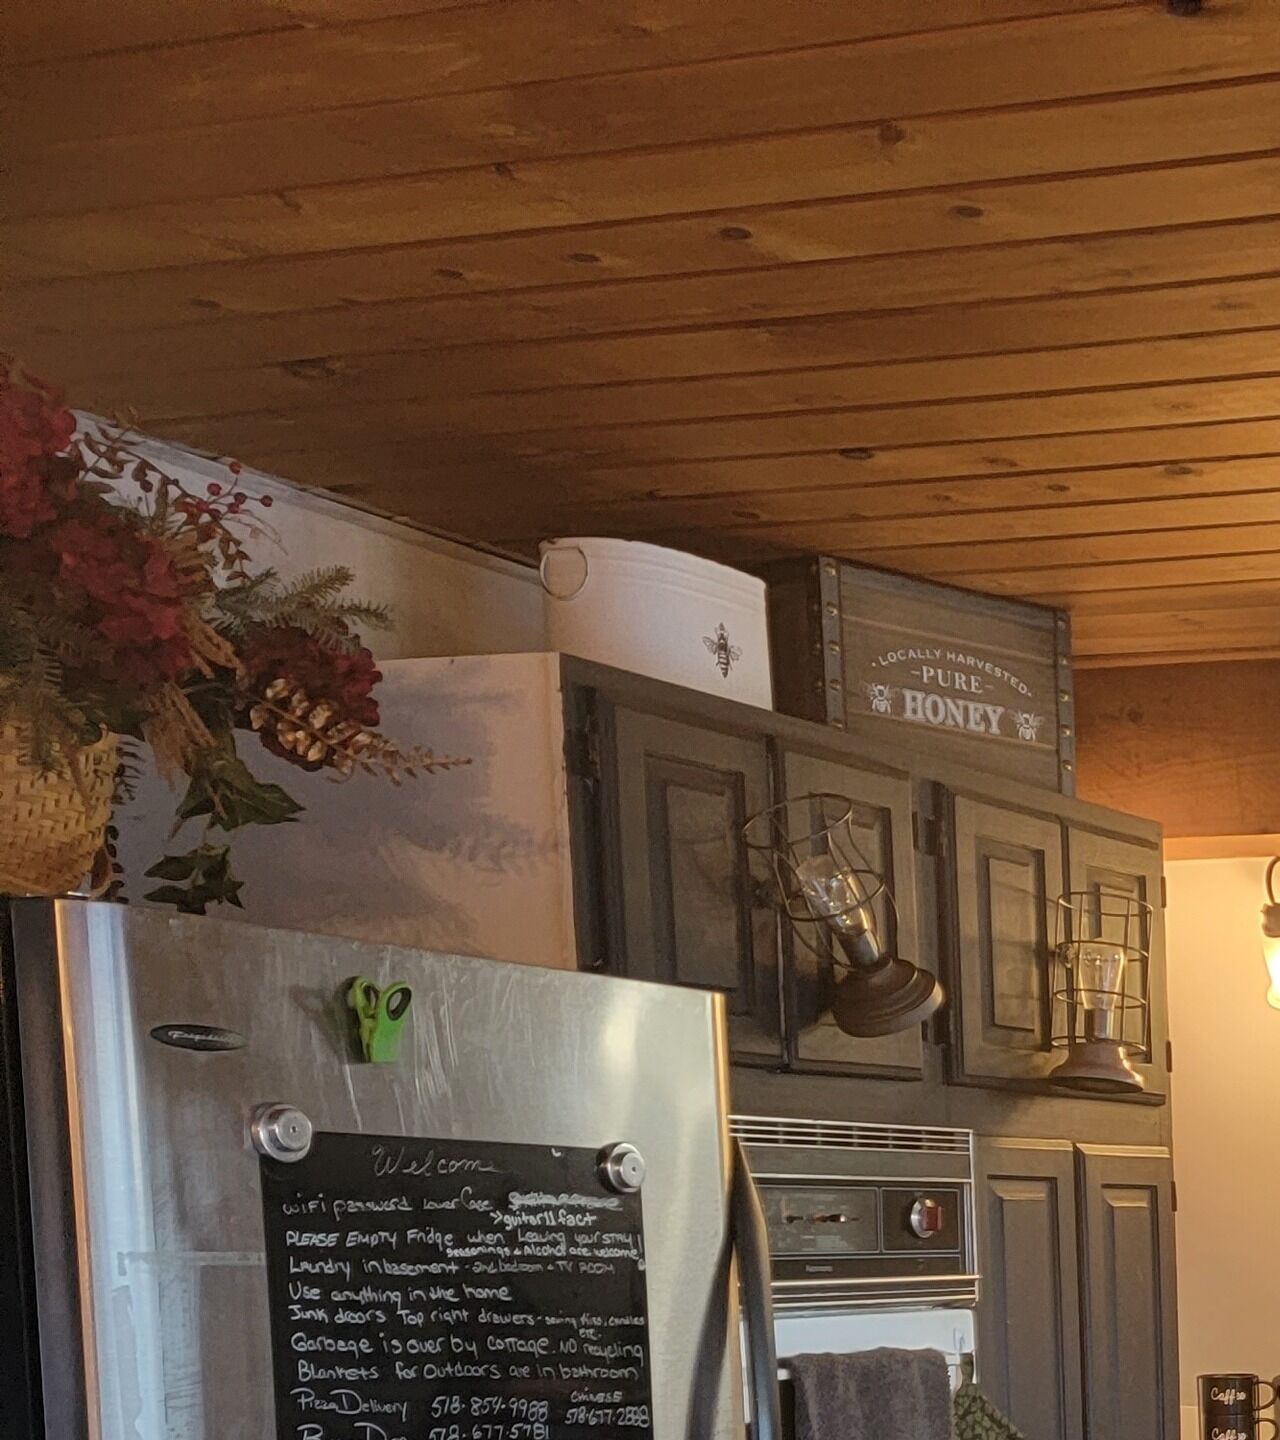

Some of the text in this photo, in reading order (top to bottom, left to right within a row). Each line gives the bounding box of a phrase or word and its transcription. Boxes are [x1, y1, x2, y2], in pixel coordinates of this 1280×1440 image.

[879, 649, 1028, 696] LOCALLY HARVESTED
[922, 666, 983, 694] PURE
[902, 687, 1005, 735] HONEY
[372, 1144, 500, 1177] Welcome
[286, 1231, 339, 1247] PLEASE
[467, 1231, 505, 1244] when
[289, 1281, 321, 1300] Use
[331, 1286, 401, 1309] anything
[429, 1286, 460, 1302] the
[463, 1283, 512, 1300] home
[379, 1332, 401, 1354] is
[406, 1336, 446, 1354] over
[450, 1335, 478, 1360] by
[297, 1359, 380, 1382] Blankets
[559, 1363, 640, 1381] bathroom
